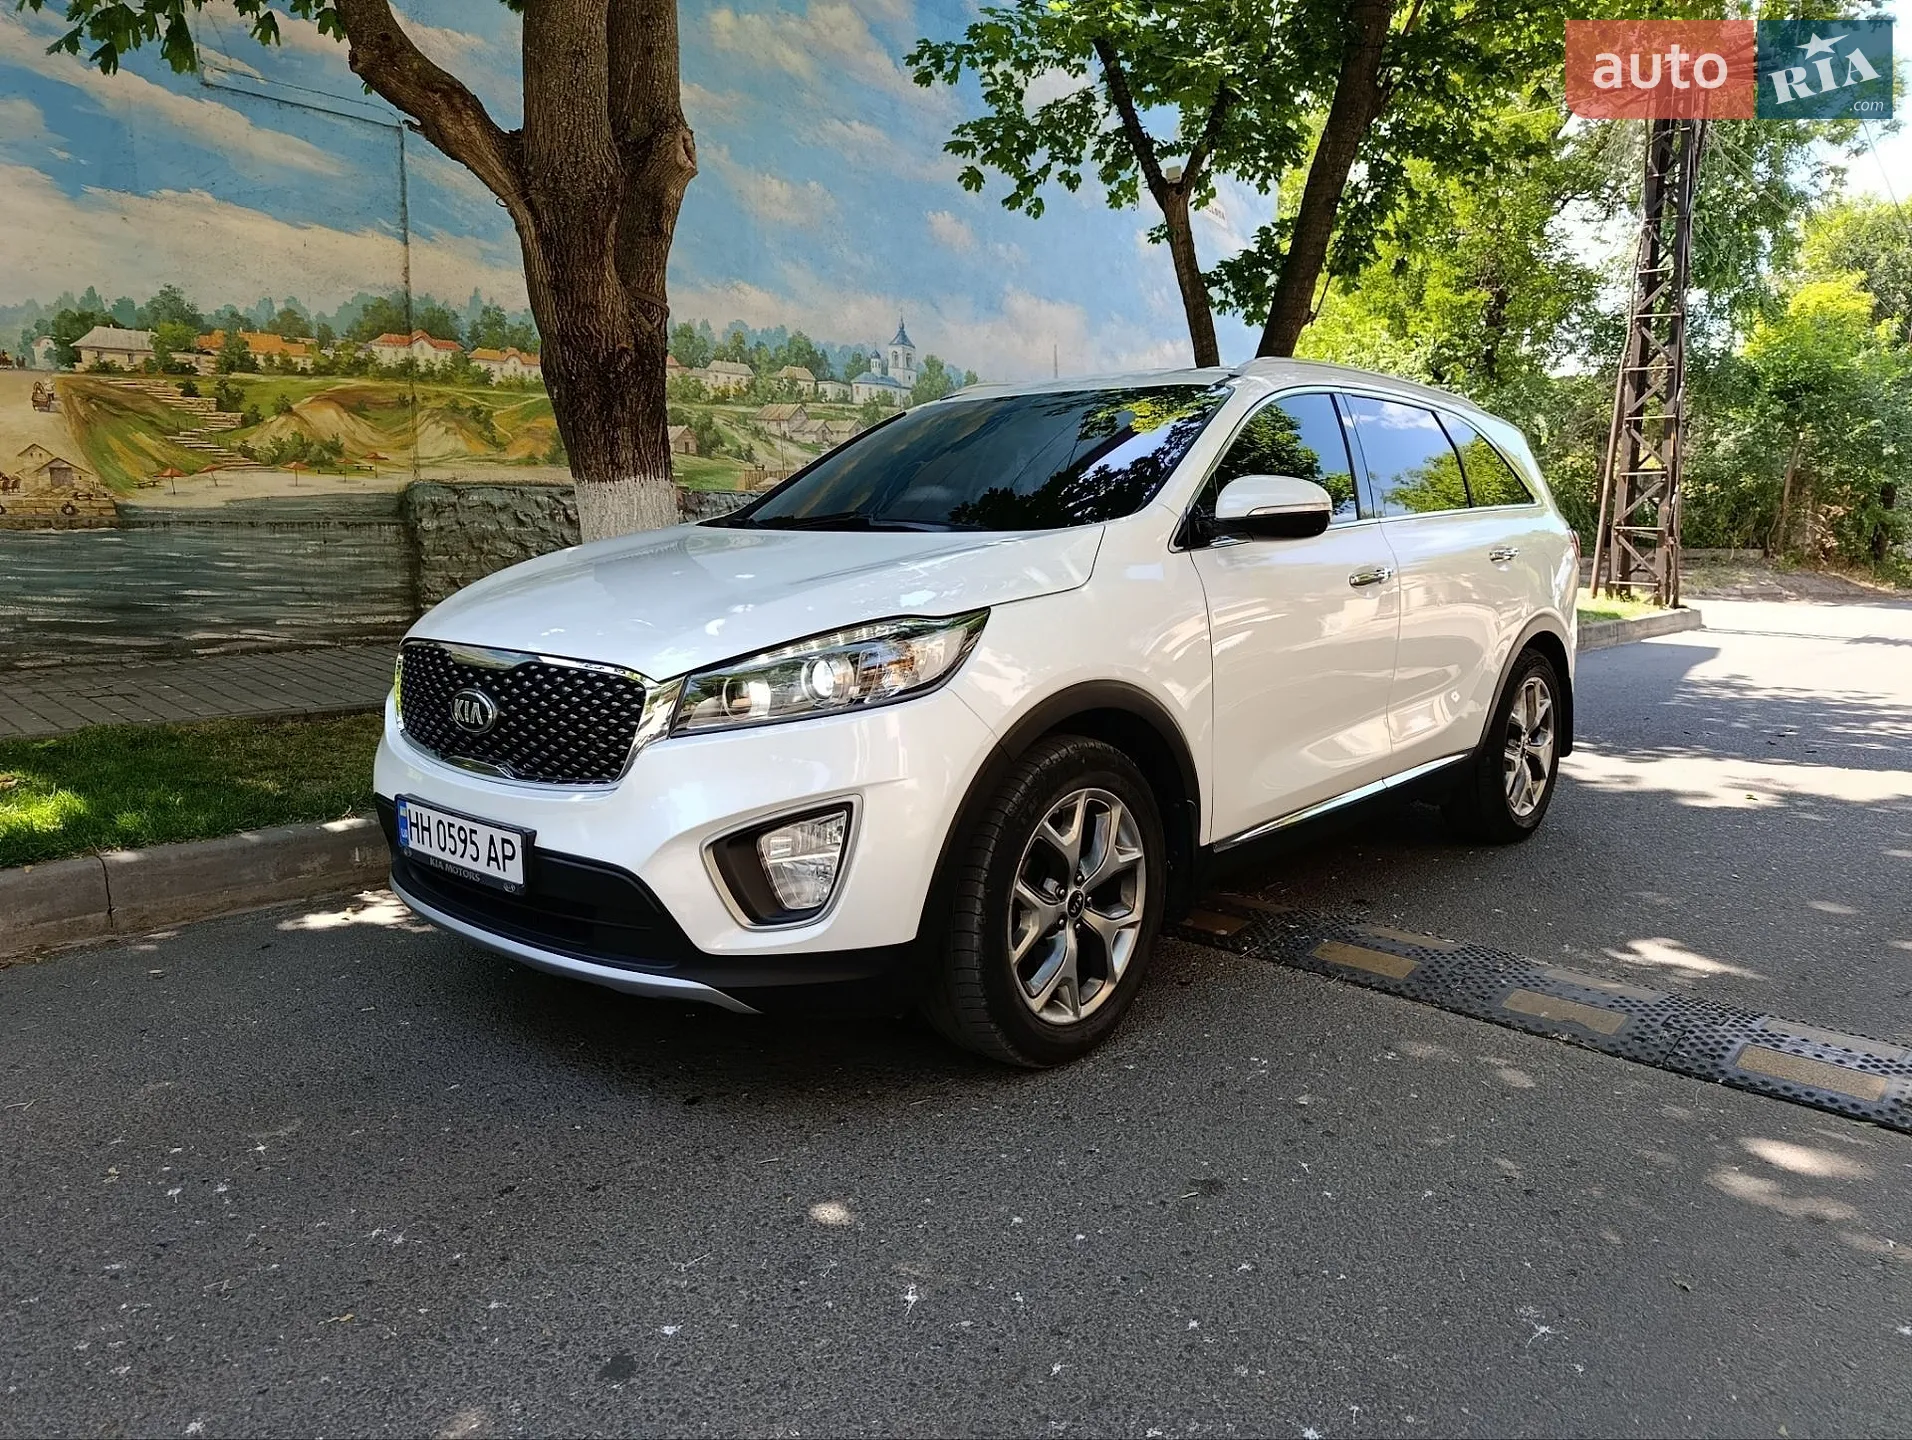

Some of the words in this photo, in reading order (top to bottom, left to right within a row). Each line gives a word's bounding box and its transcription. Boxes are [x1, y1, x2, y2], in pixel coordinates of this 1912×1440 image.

[453, 698, 484, 726] KIA
[408, 808, 433, 849] HH
[436, 818, 480, 863] 0595
[486, 833, 516, 873] AP
[429, 857, 444, 872] KIA
[445, 863, 481, 883] MOTORS
